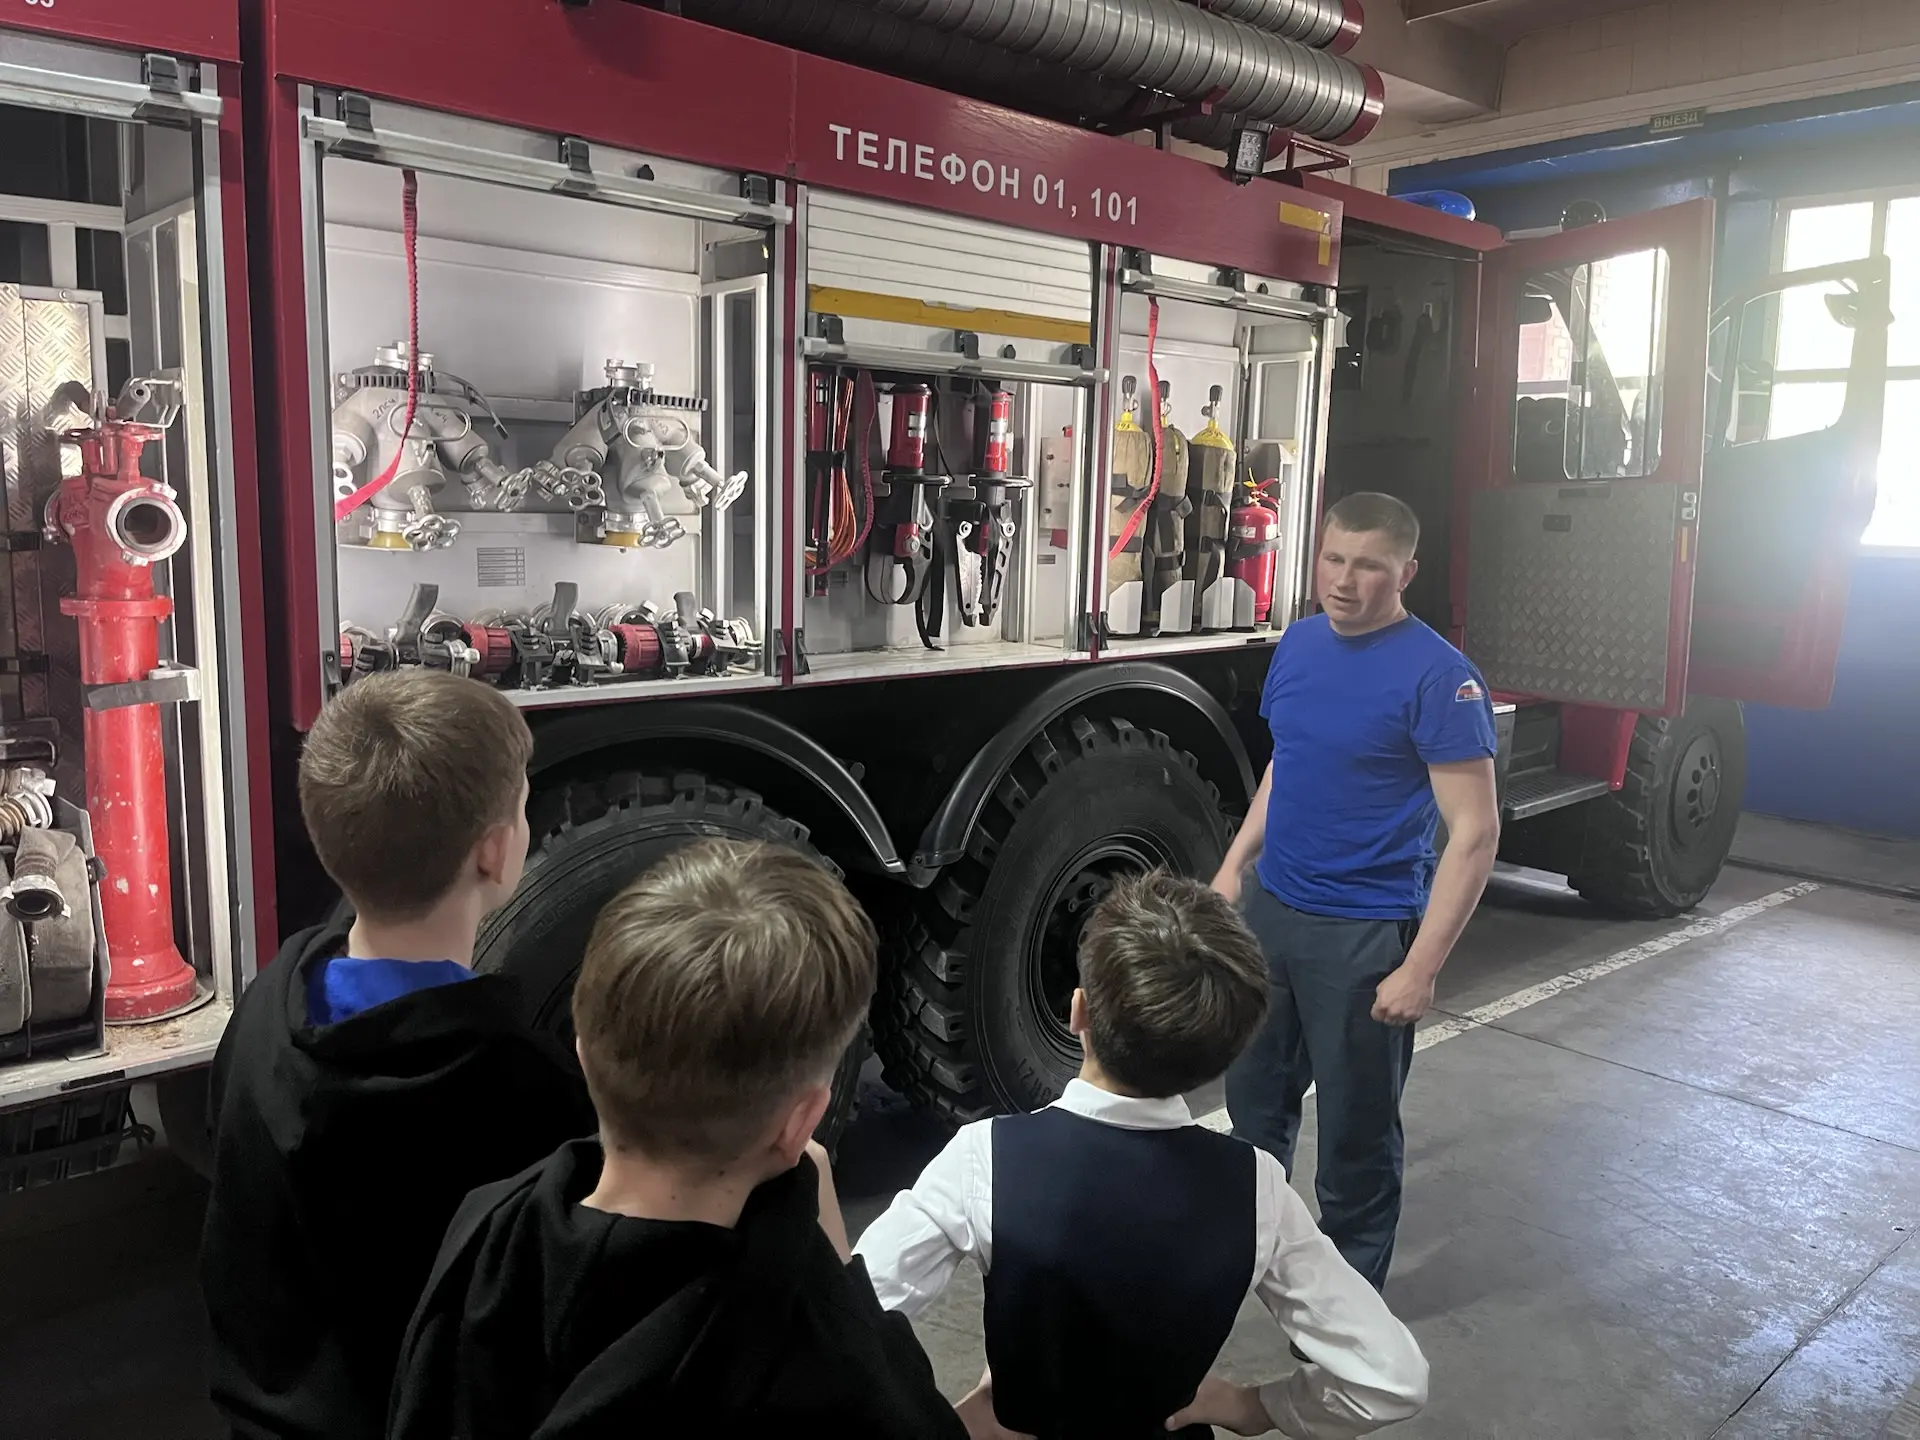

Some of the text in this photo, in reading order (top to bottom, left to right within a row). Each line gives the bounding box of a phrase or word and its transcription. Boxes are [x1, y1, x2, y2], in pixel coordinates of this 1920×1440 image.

[1653, 111, 1699, 129] ВЫЕЗД
[829, 124, 1137, 225] ТЕЛЕФОН 01, 101
